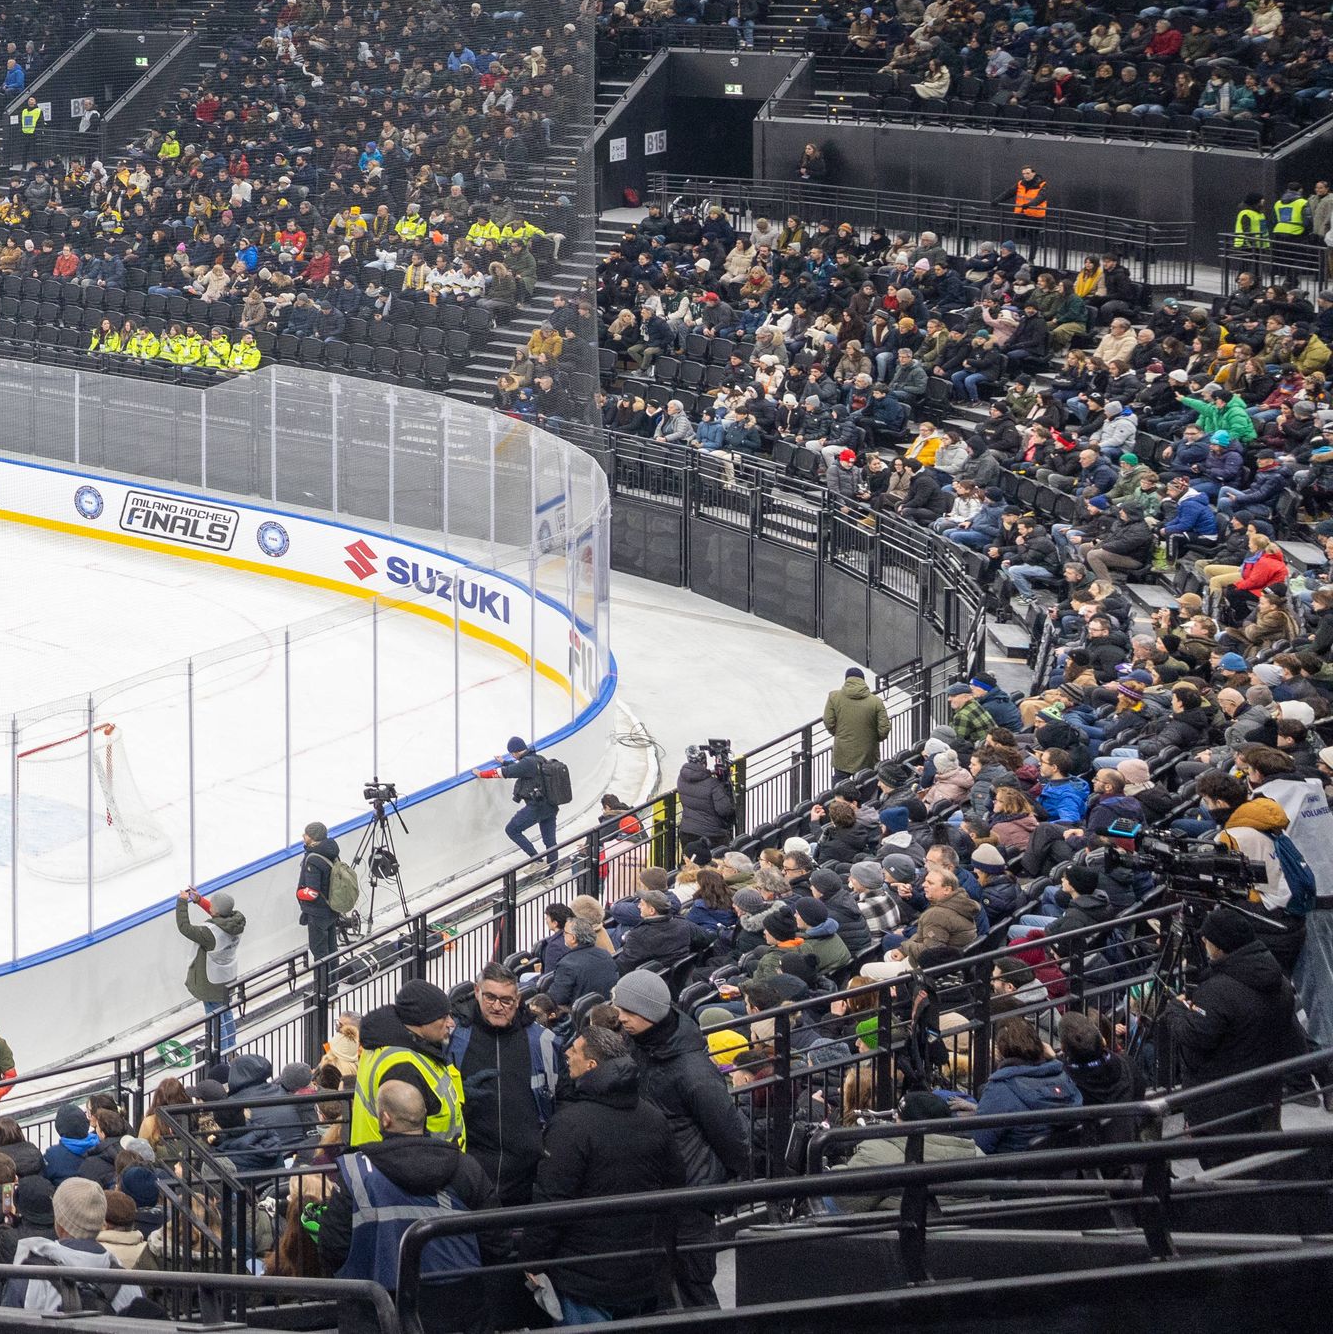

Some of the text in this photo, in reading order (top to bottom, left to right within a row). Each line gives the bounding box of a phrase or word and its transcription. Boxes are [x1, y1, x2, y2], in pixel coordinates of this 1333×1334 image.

[647, 132, 666, 152] B15
[127, 507, 229, 544] FINALS
[131, 497, 232, 524] MILANO HOCKEY
[386, 556, 510, 624] SUZUKI
